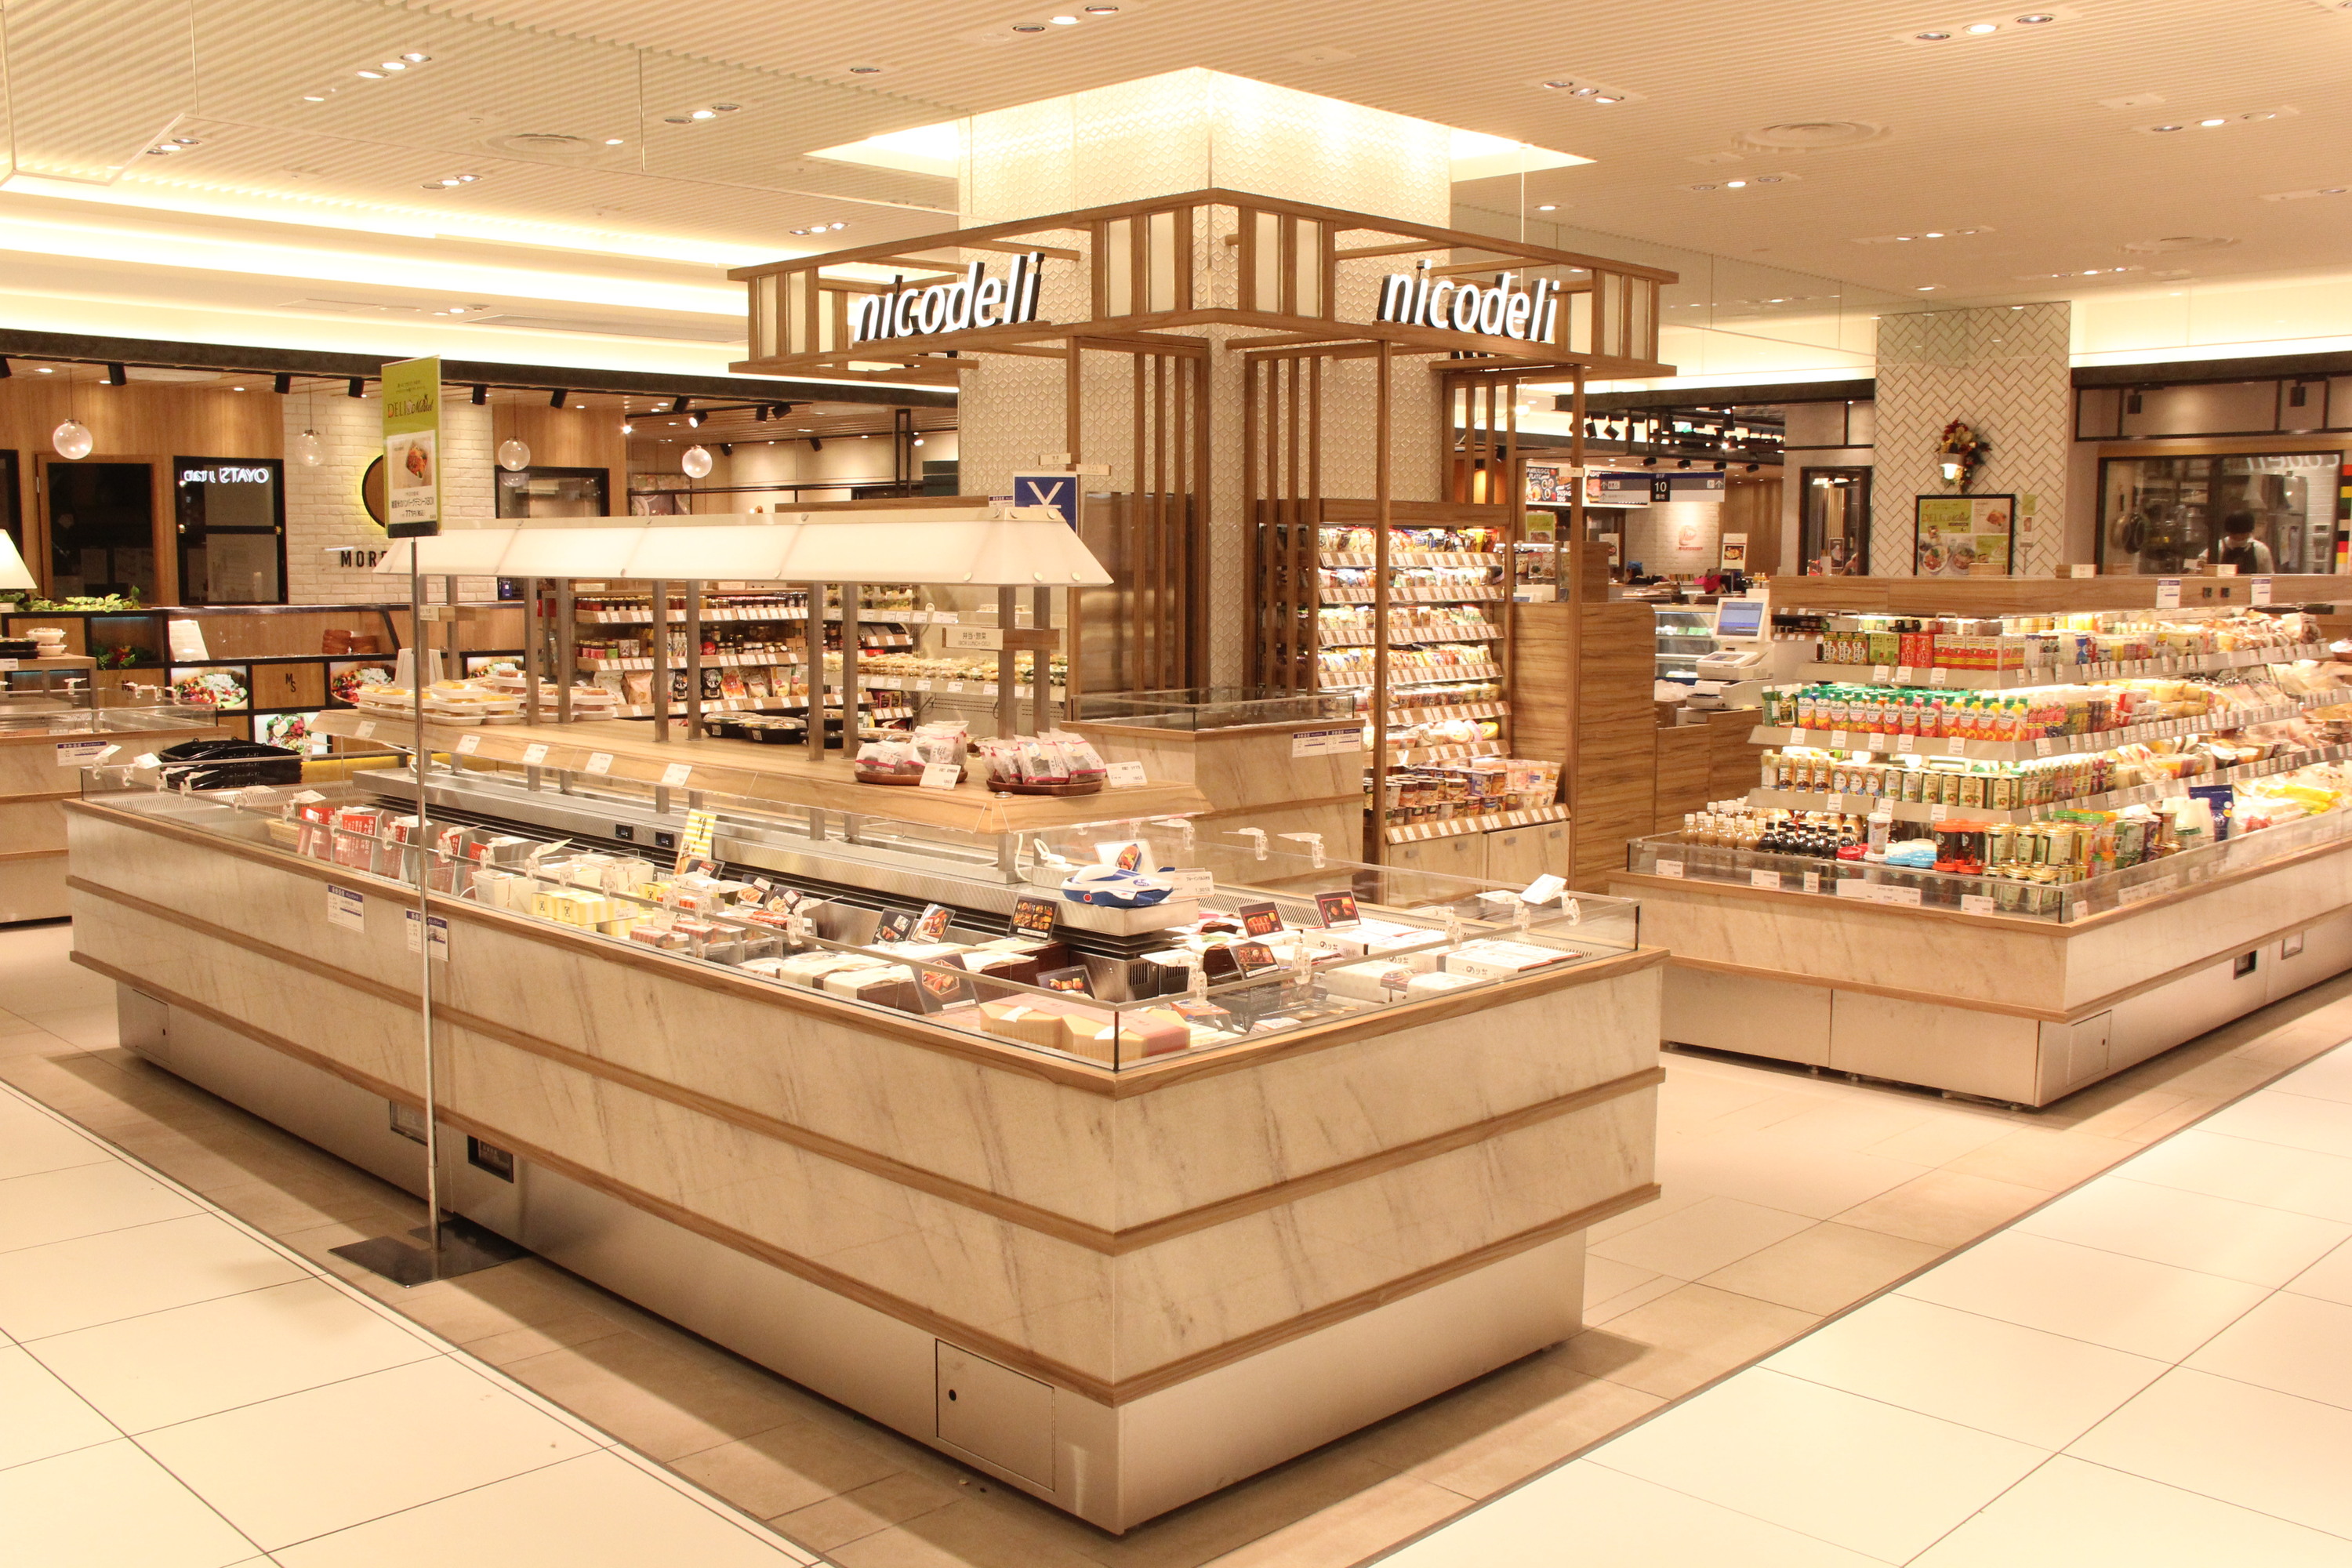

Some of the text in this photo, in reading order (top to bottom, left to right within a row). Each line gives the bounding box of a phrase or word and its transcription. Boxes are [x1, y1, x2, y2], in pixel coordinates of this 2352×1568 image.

[854, 252, 1044, 343] nicodeli
[1381, 259, 1560, 343] nicodeli
[1654, 481, 1668, 492] 10
